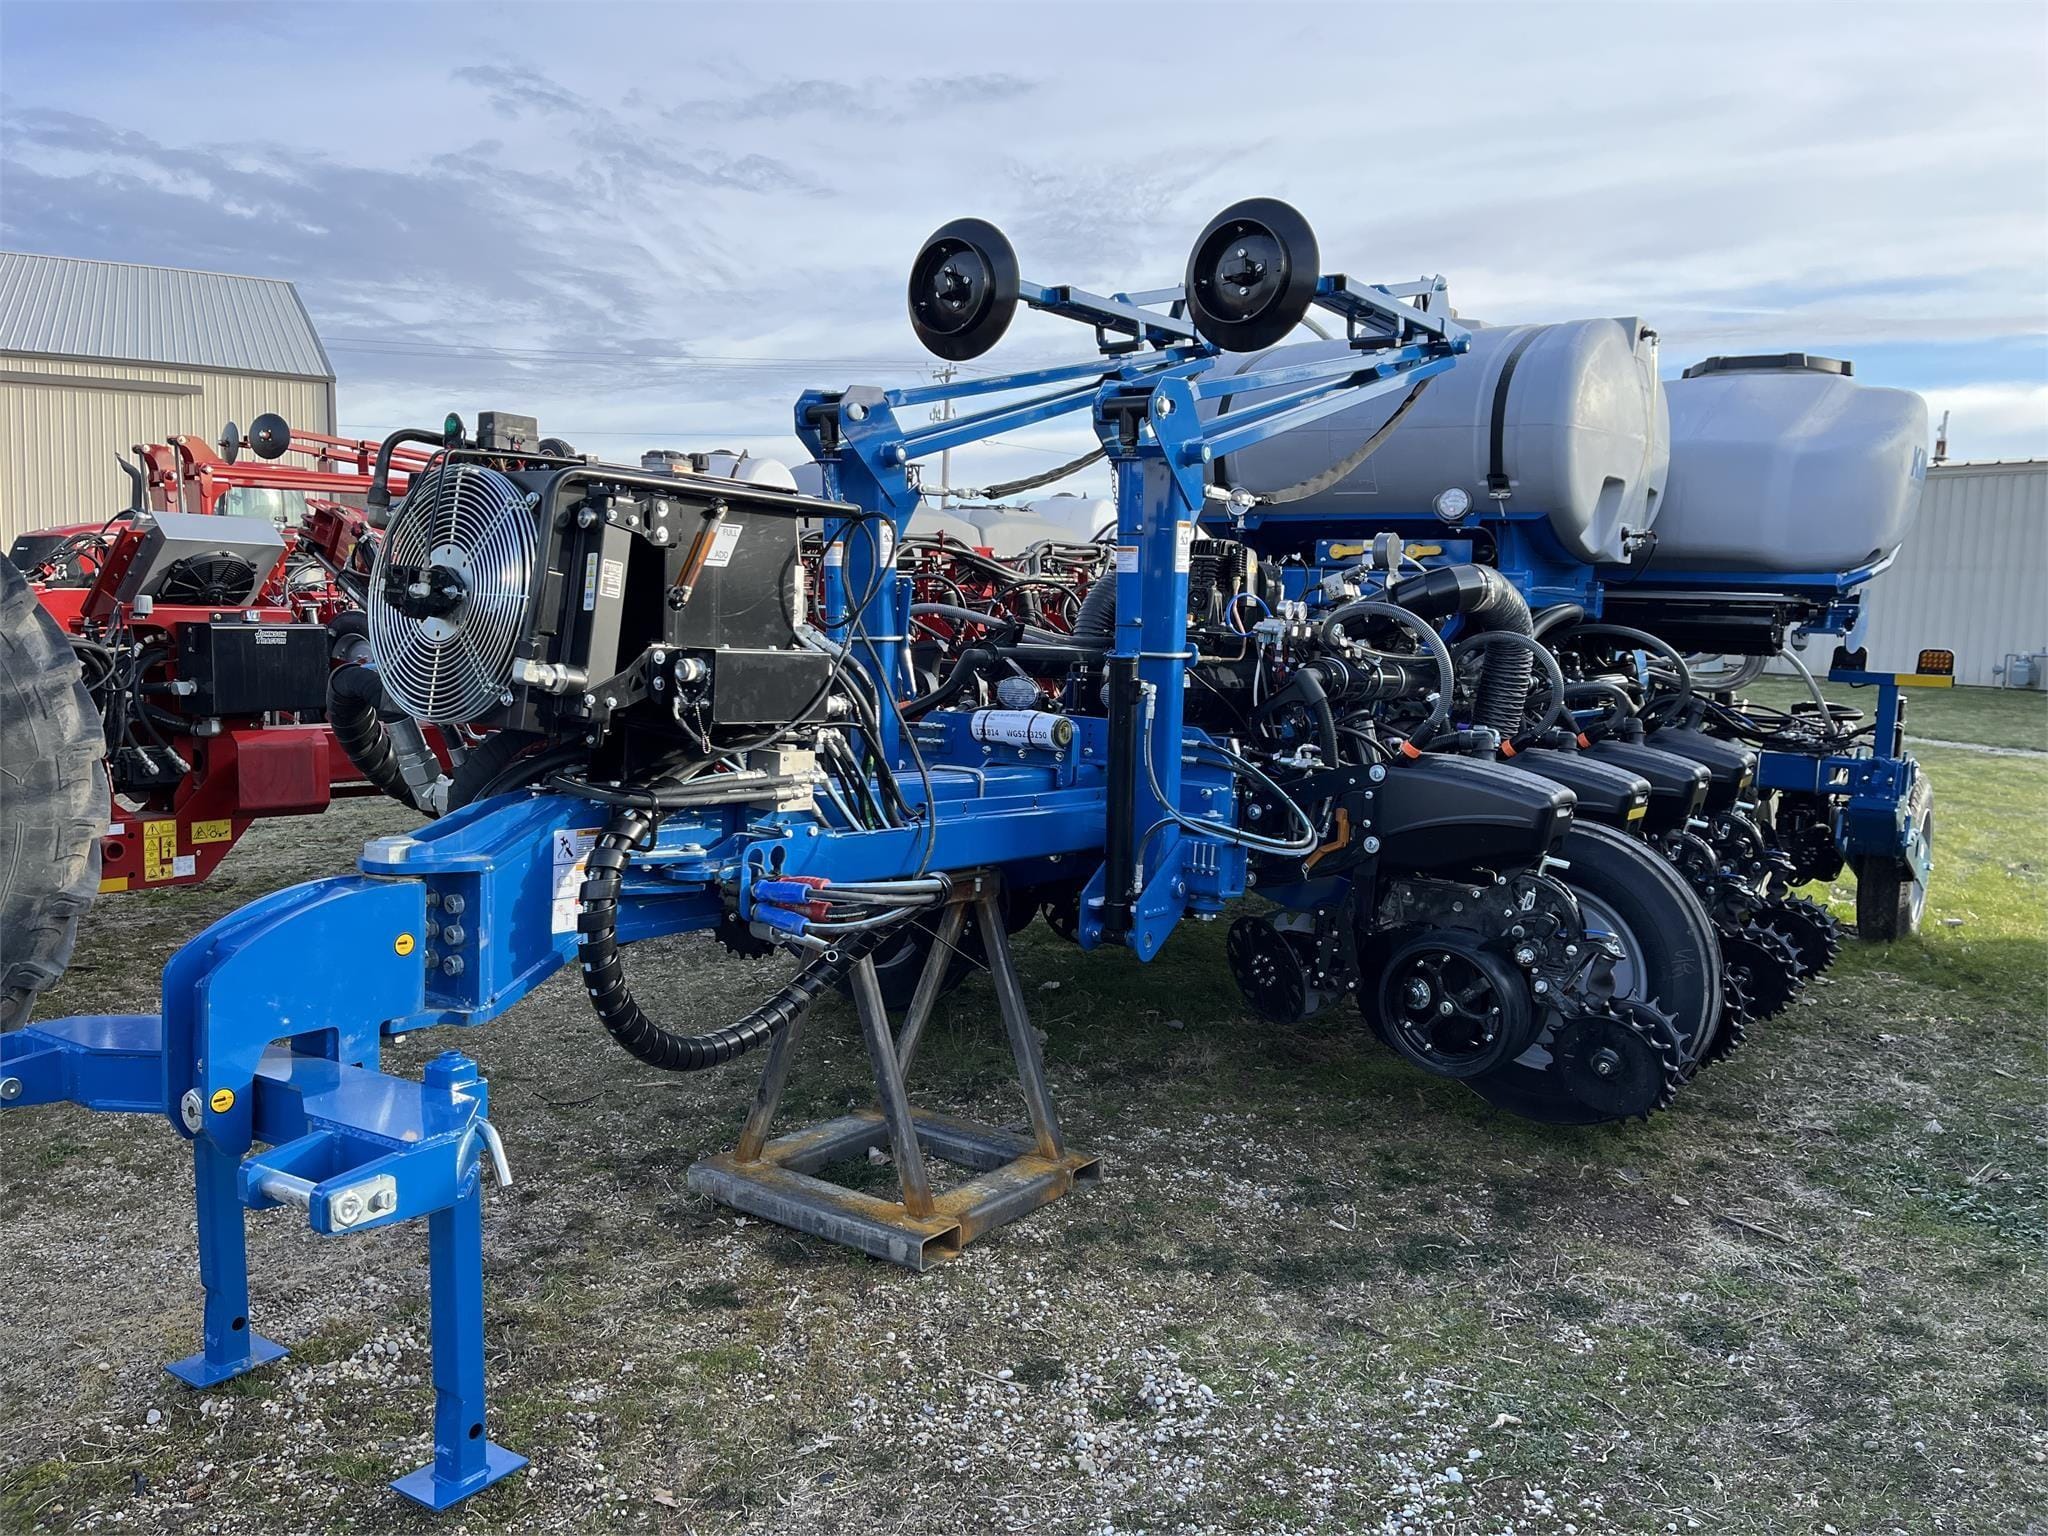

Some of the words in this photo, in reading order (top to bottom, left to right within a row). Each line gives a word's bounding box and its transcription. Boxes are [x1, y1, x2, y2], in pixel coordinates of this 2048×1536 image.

[722, 528, 738, 536] FULL
[715, 550, 728, 559] ADD
[1006, 729, 1047, 739] WGS23250
